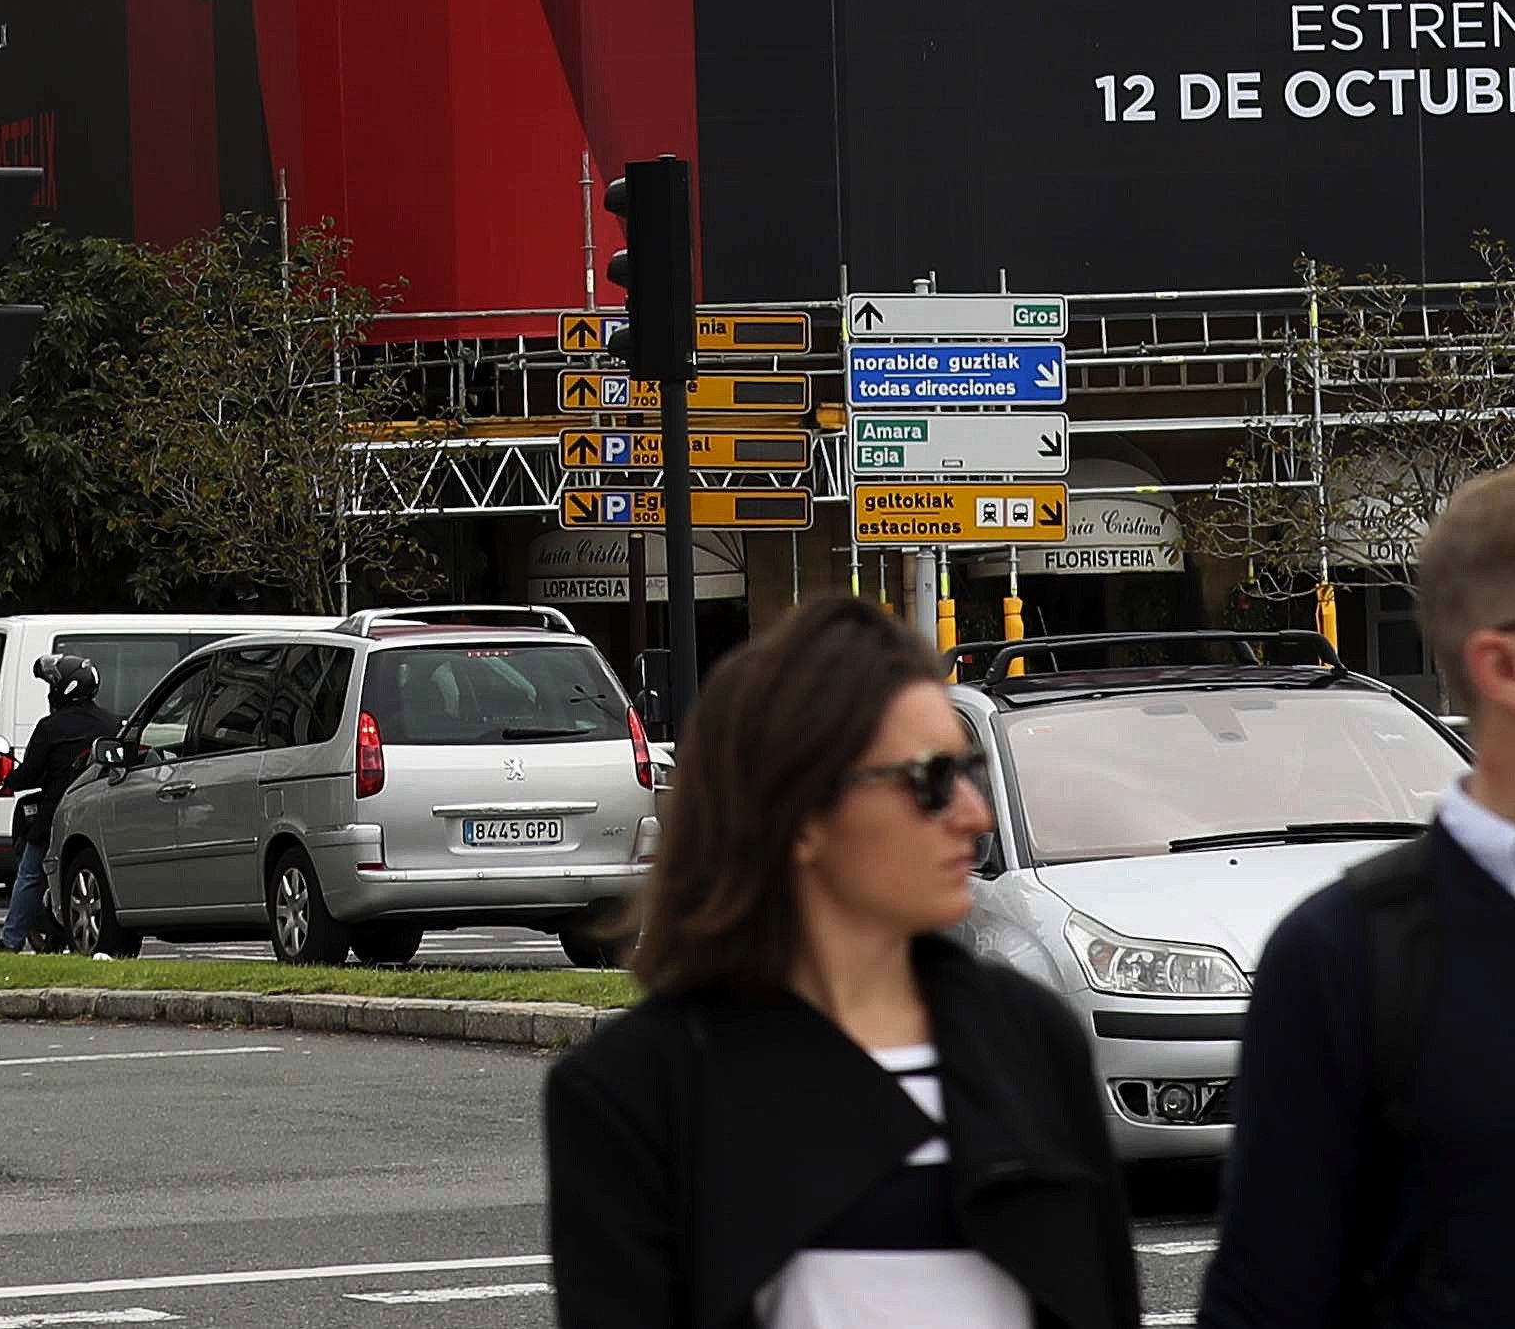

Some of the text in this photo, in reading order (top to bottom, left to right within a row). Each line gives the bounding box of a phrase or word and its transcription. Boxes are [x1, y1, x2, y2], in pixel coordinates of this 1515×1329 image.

[1094, 74, 1154, 123] 12
[1179, 71, 1263, 120] DE
[1014, 308, 1060, 324] Gros
[853, 352, 1021, 373] norabide guztiak
[859, 379, 1016, 397] todas direcciones
[632, 395, 658, 406] 700
[862, 423, 922, 439] Amara
[633, 454, 659, 465] 900
[861, 447, 900, 466] Egia
[865, 493, 954, 511] geltokiak
[634, 512, 660, 523] 500
[1101, 509, 1162, 536] Cristina
[858, 518, 962, 536] estaciones
[574, 538, 630, 564] Cristin
[1045, 549, 1155, 569] FLORISTERIA
[543, 580, 626, 598] LORATEGIA
[475, 821, 559, 840] 8445 GPD
